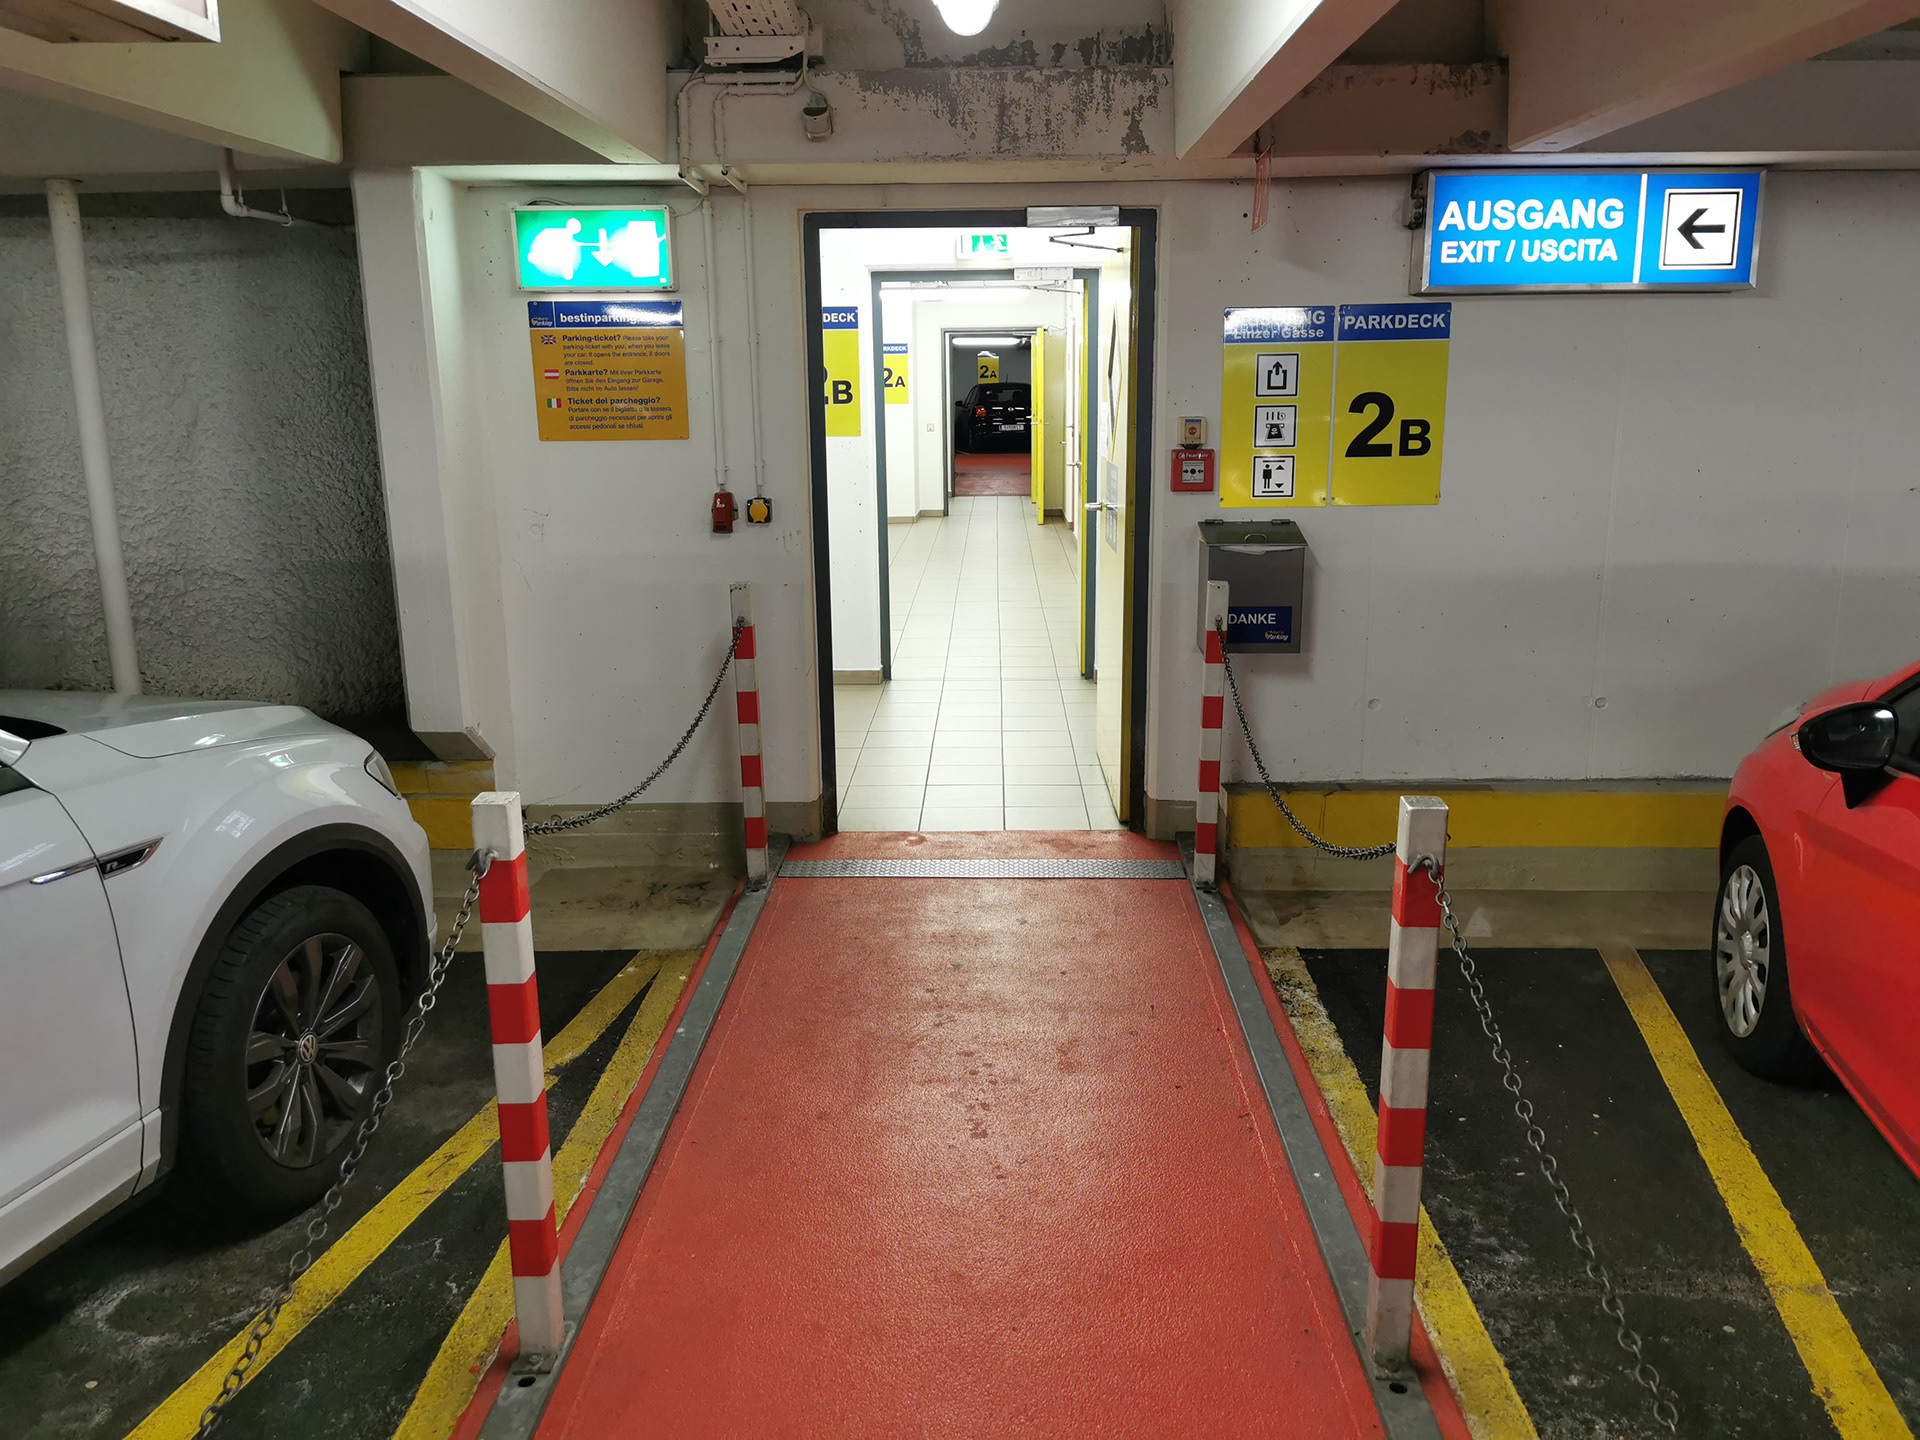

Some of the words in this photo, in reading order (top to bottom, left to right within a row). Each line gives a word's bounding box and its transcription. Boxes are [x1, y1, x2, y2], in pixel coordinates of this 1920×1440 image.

[1438, 198, 1625, 231] AUSGANG
[1441, 240, 1501, 265] EXIT
[1505, 239, 1516, 263] /
[1521, 238, 1618, 263] USCITA
[1344, 313, 1446, 330] PARKDECK
[562, 334, 621, 344] Parking-ticket?
[1281, 327, 1325, 339] Gasse
[563, 343, 601, 351] parking-ticket
[565, 368, 608, 376] Parkkarte?
[979, 365, 997, 379] 2A
[824, 366, 853, 405] B
[567, 397, 593, 405] Ticket
[595, 397, 608, 405] del
[610, 397, 661, 406] parcheggio?
[1345, 391, 1431, 457] 2B
[1228, 613, 1277, 625] DANKE
